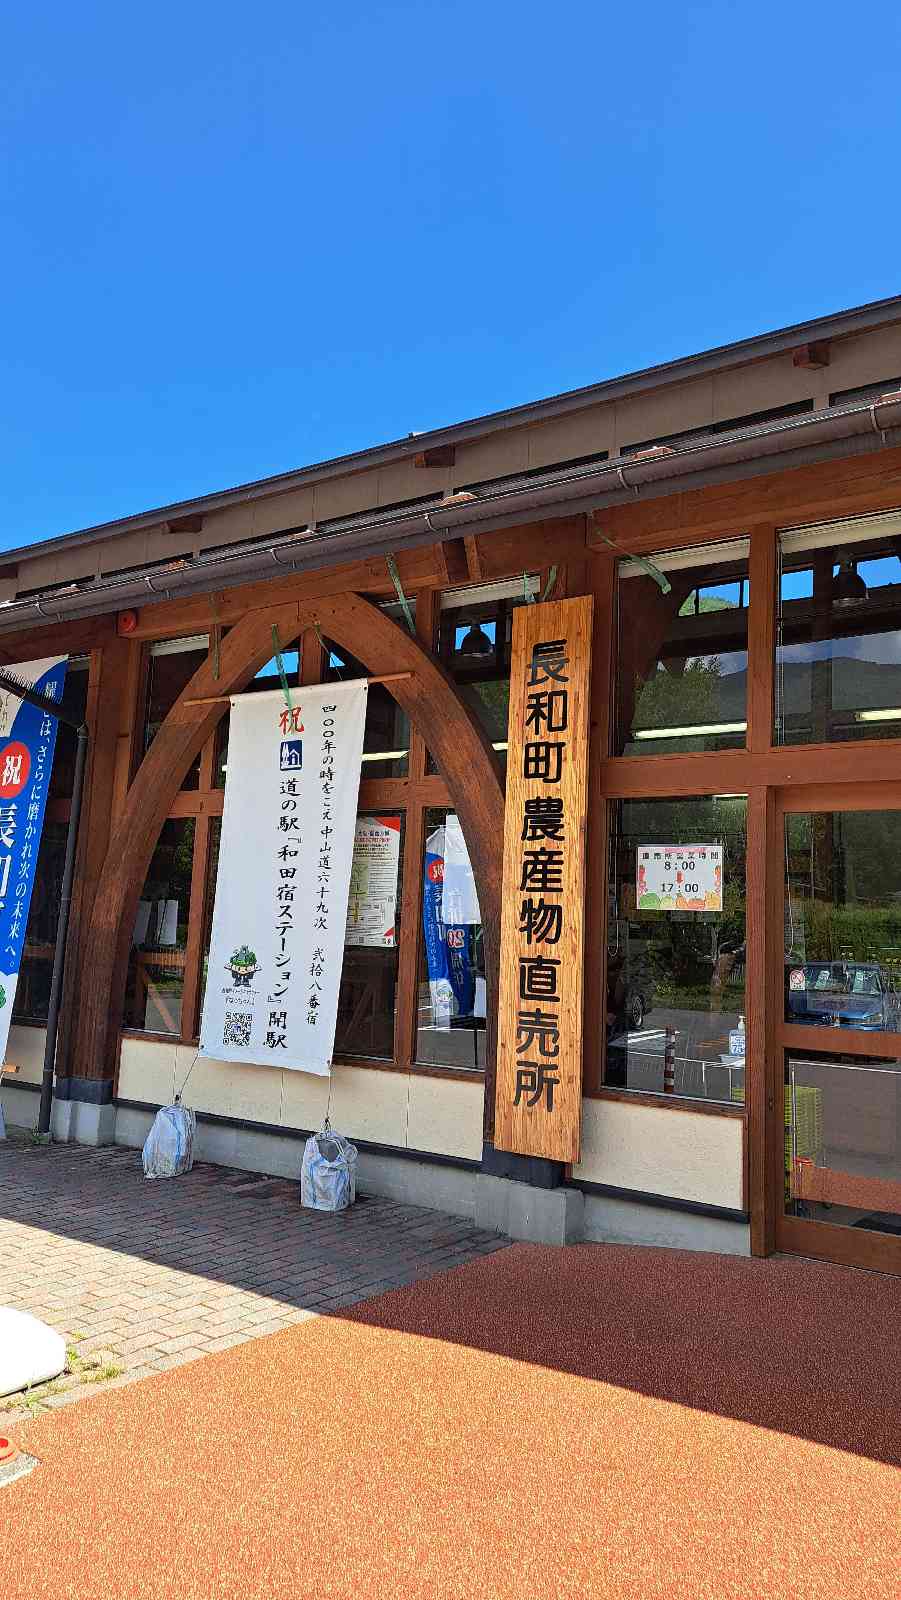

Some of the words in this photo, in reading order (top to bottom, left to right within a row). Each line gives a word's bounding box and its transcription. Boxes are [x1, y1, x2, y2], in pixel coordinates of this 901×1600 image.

[279, 702, 305, 735] 祝
[2, 753, 23, 786] 祝
[514, 638, 569, 1112] 長和町農産物直売所
[664, 861, 695, 870] 8:00
[661, 883, 699, 892] 17:00
